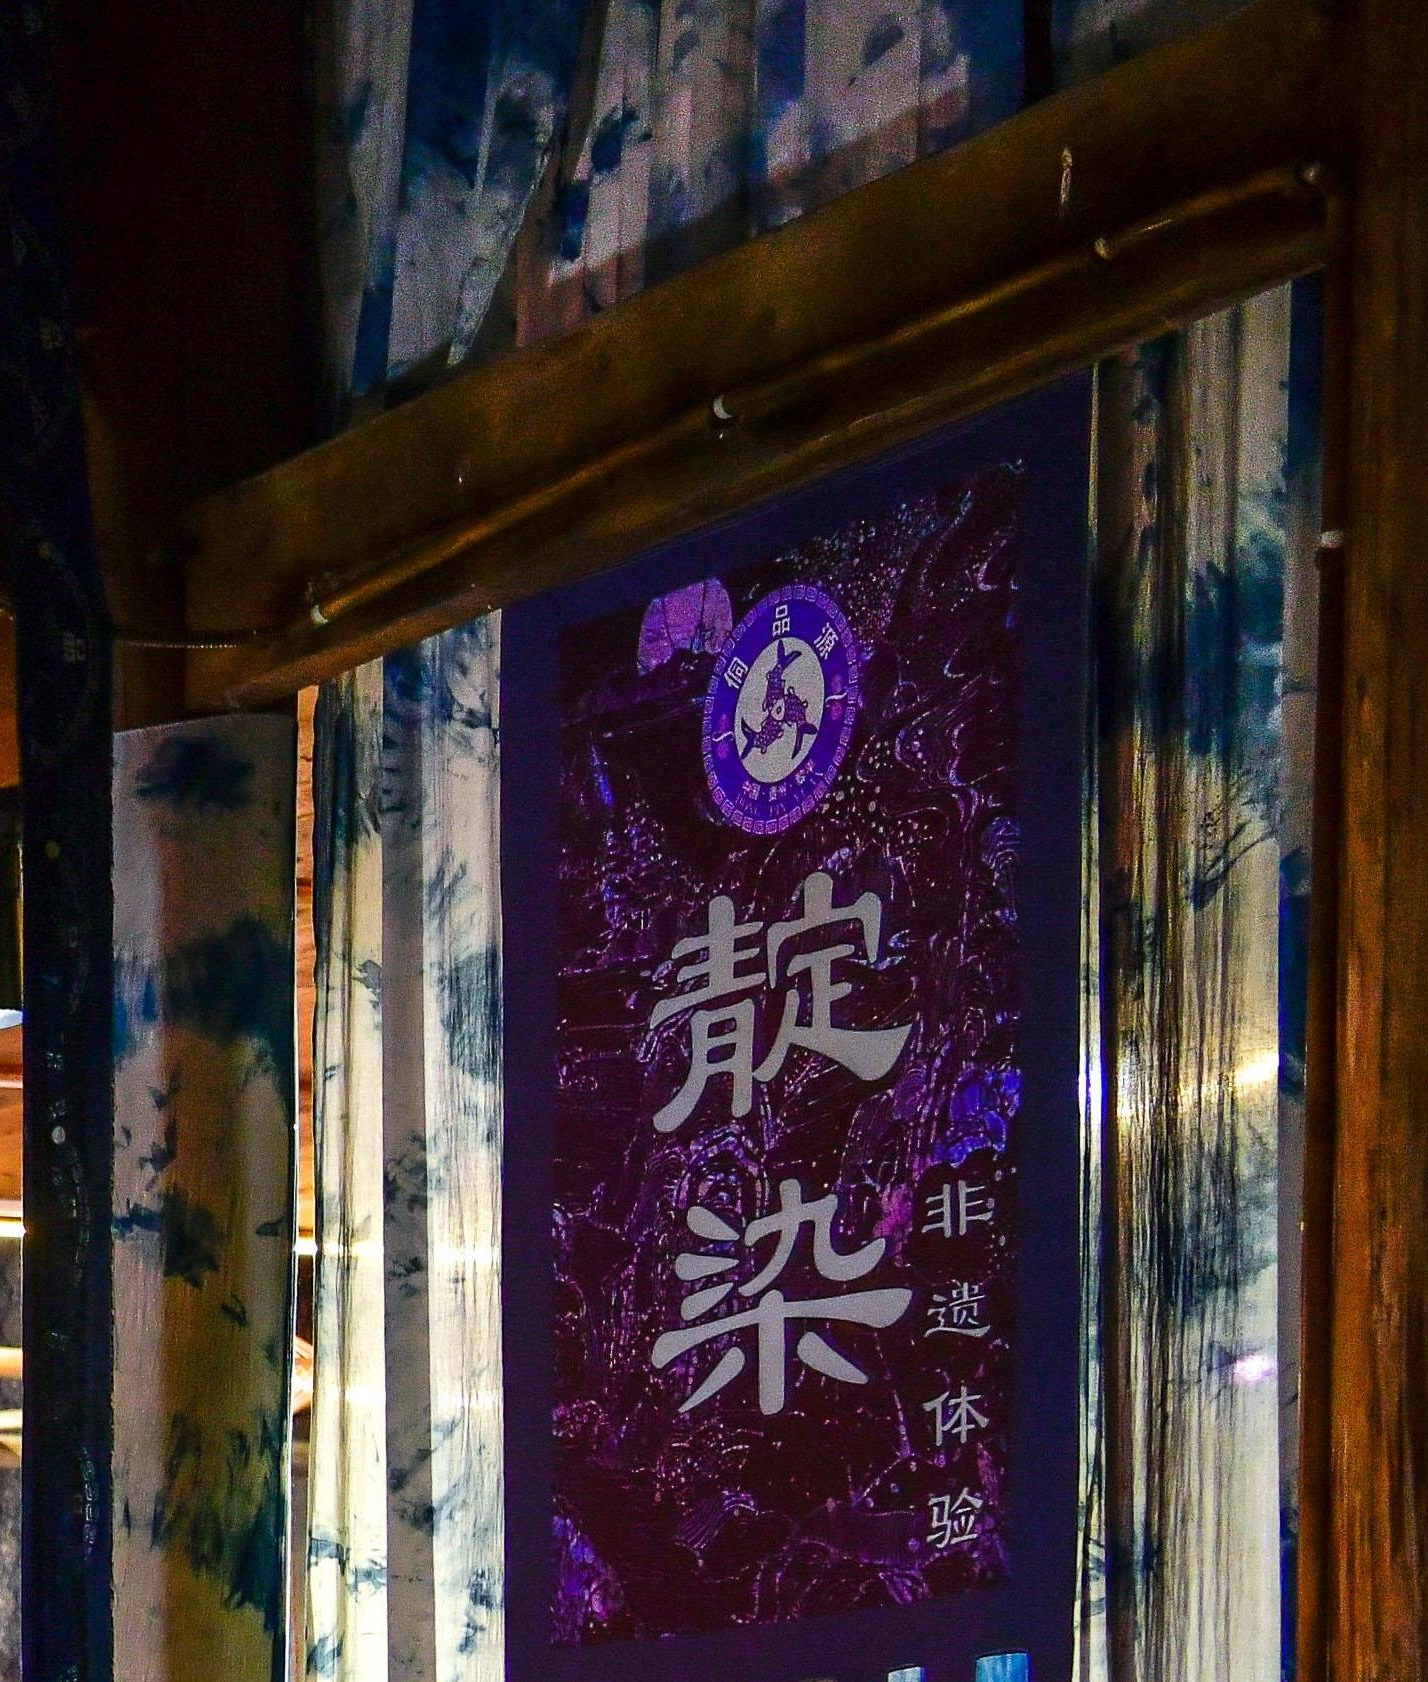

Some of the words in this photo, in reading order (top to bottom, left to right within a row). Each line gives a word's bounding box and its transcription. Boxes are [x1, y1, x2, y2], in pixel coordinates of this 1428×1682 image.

[723, 604, 839, 689] 侗品源
[649, 871, 915, 1414] 靛染
[921, 1180, 994, 1548] 非遗体验
